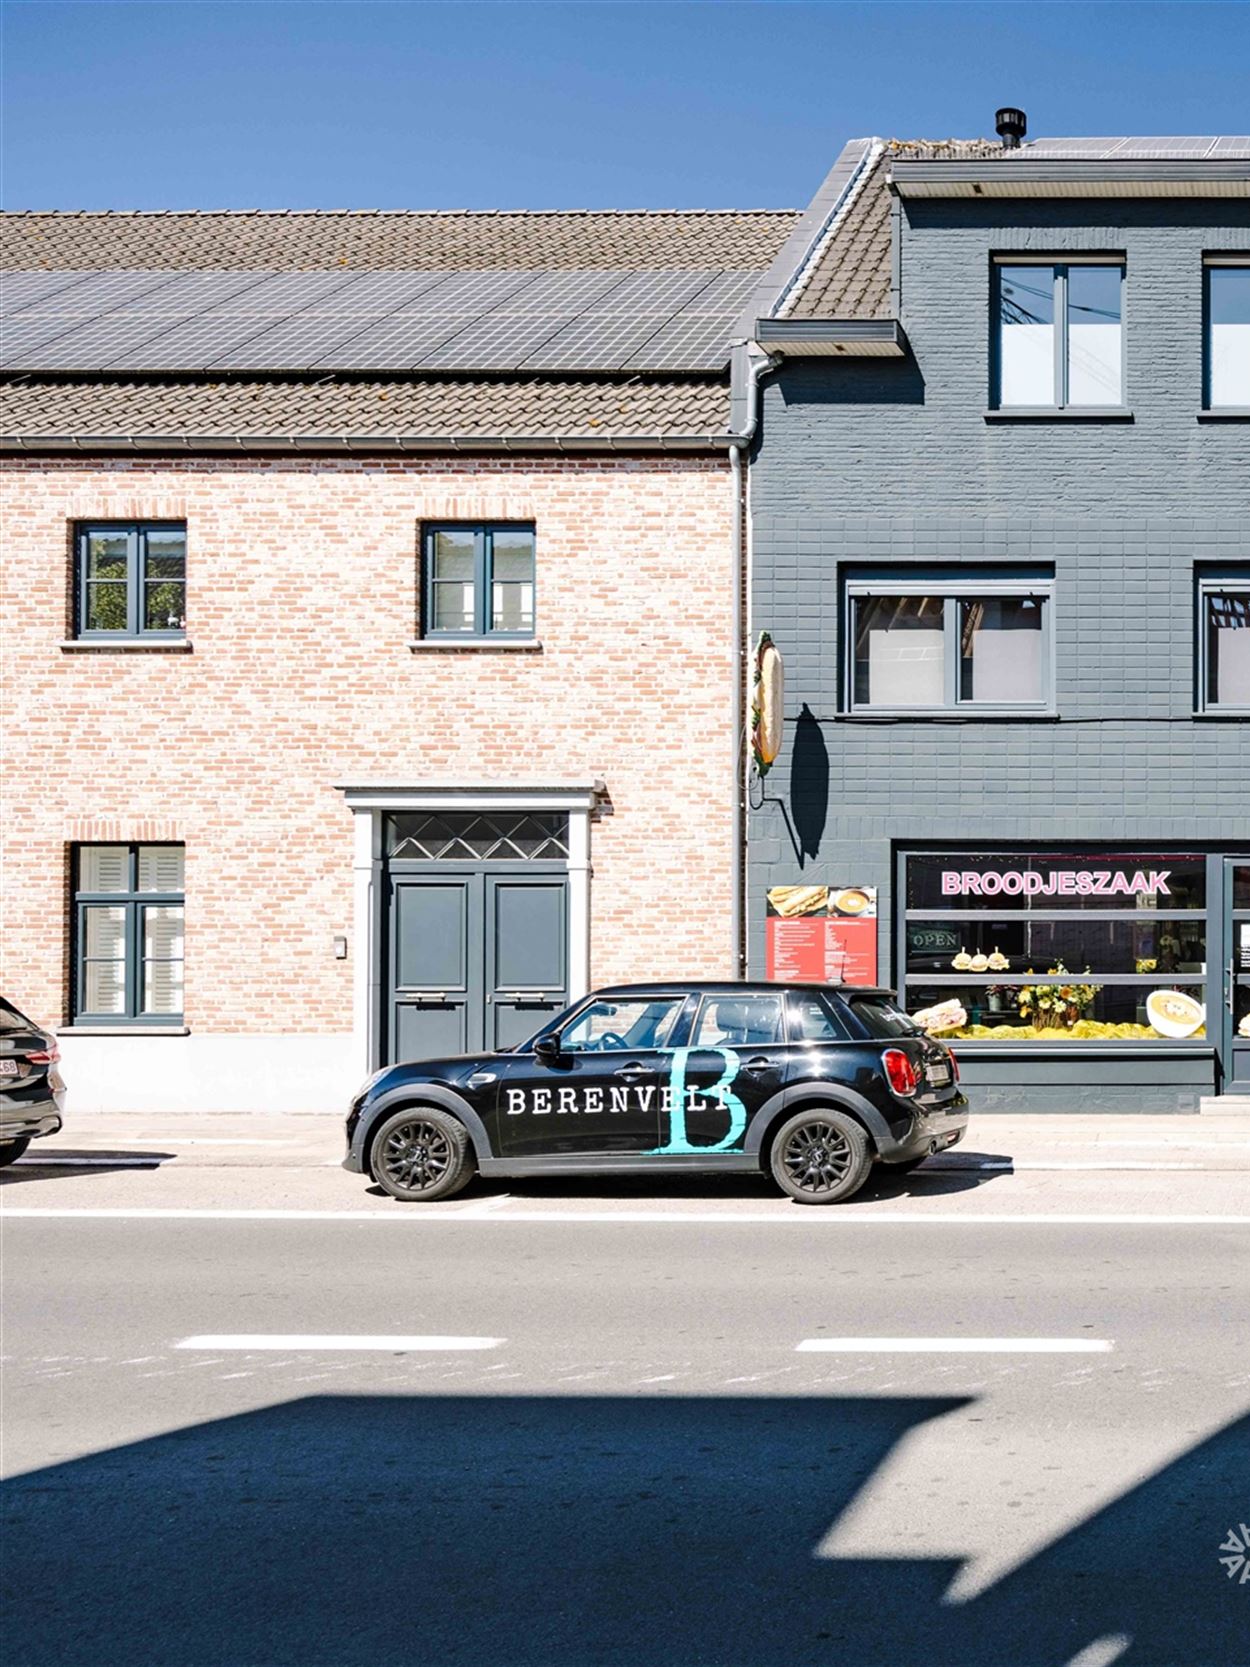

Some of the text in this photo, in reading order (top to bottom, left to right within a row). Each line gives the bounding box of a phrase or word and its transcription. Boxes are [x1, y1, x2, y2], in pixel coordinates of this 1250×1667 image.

[941, 871, 1172, 895] BROODJESZAAK
[913, 934, 957, 946] OPEN
[0, 1061, 16, 1073] 68
[506, 1085, 732, 1115] BERENVELT
